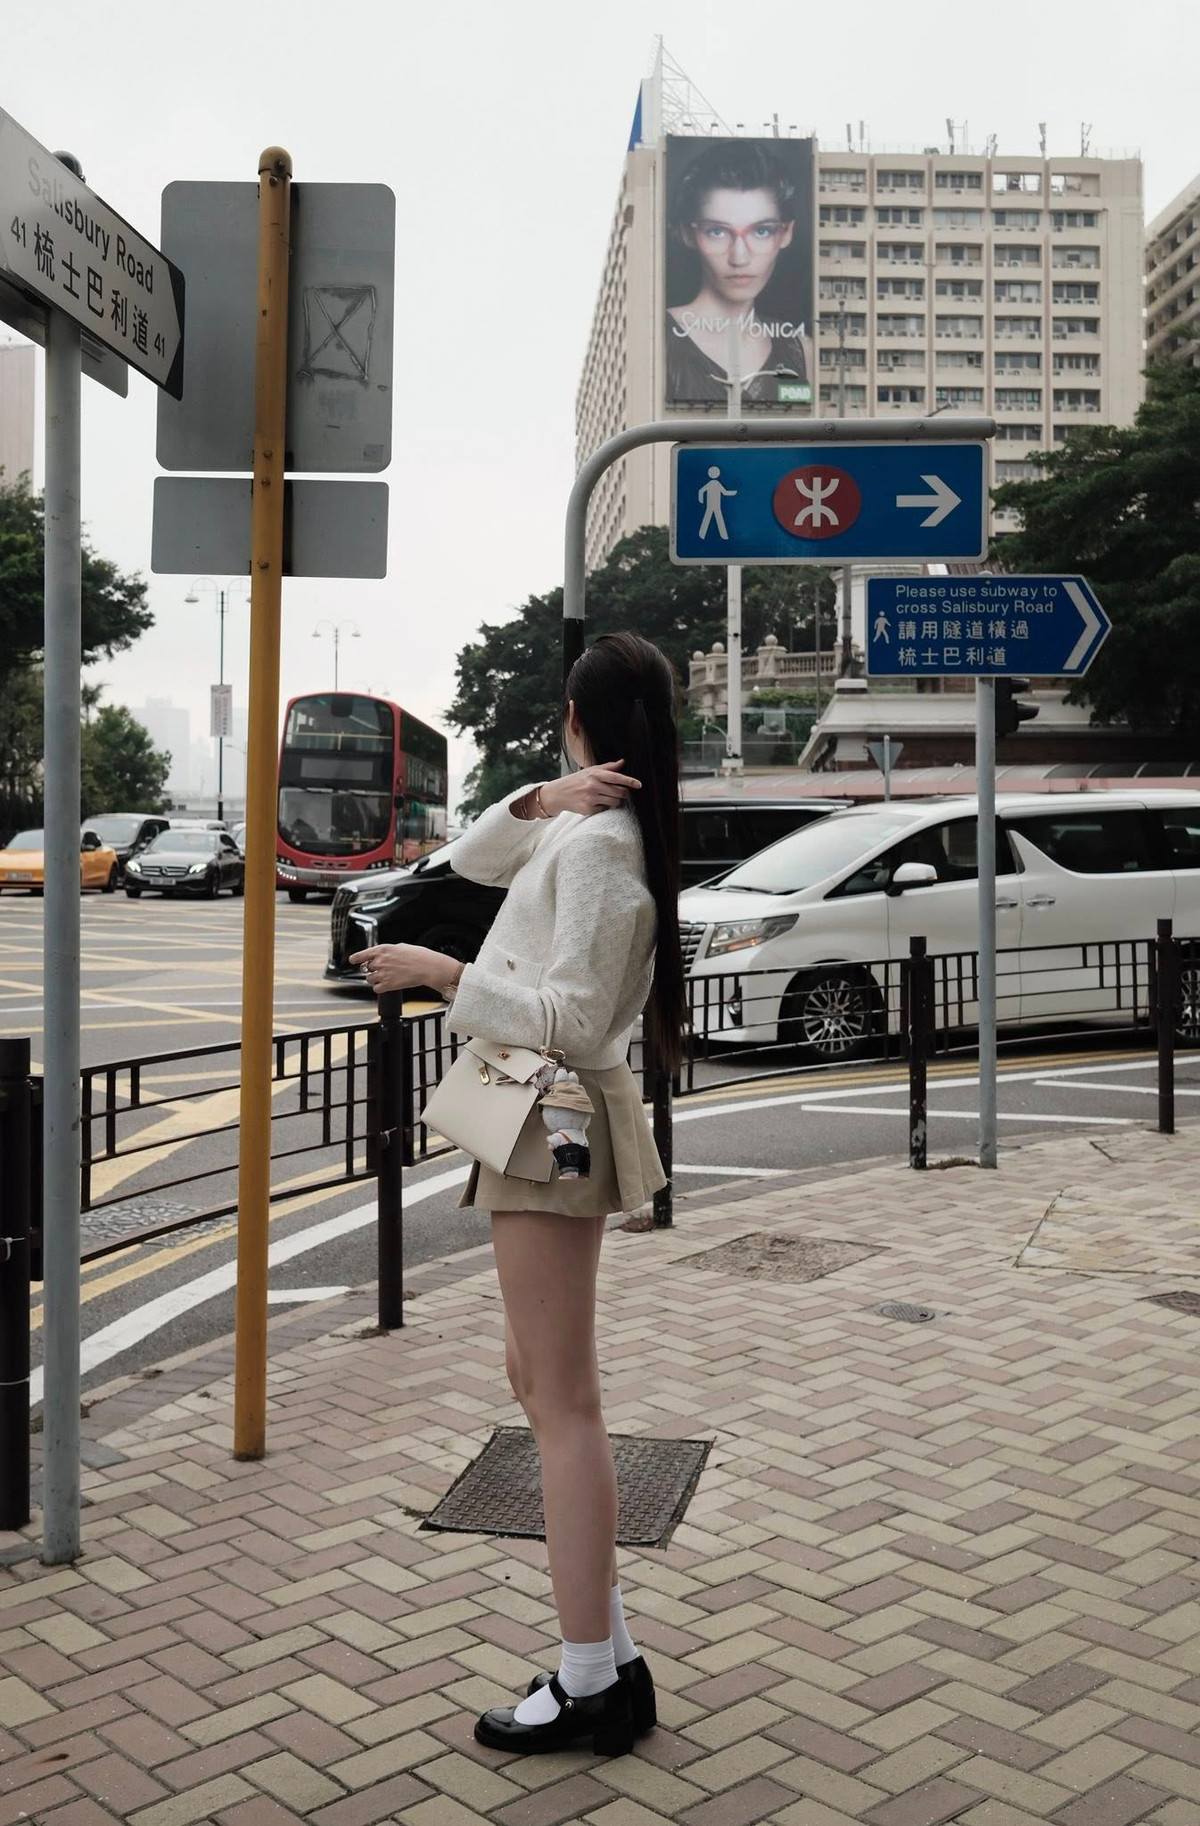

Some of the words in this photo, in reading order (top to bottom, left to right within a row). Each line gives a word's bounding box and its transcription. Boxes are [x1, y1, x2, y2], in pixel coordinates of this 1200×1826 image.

[28, 156, 110, 261] Salisbury
[117, 234, 153, 294] Road
[11, 216, 26, 248] 41
[34, 222, 149, 355] 梳士巴利道
[153, 332, 165, 358] 41
[736, 307, 806, 339] MONICA
[895, 584, 946, 598] Please
[950, 587, 977, 597] use
[980, 585, 1038, 600] subway
[1043, 585, 1058, 597] to
[895, 602, 937, 614] cross
[941, 600, 1009, 616] Salisbury
[1014, 599, 1054, 614] Road
[898, 620, 1029, 640] 請用隧道橫過
[898, 646, 1007, 667] 梳士巴利道
